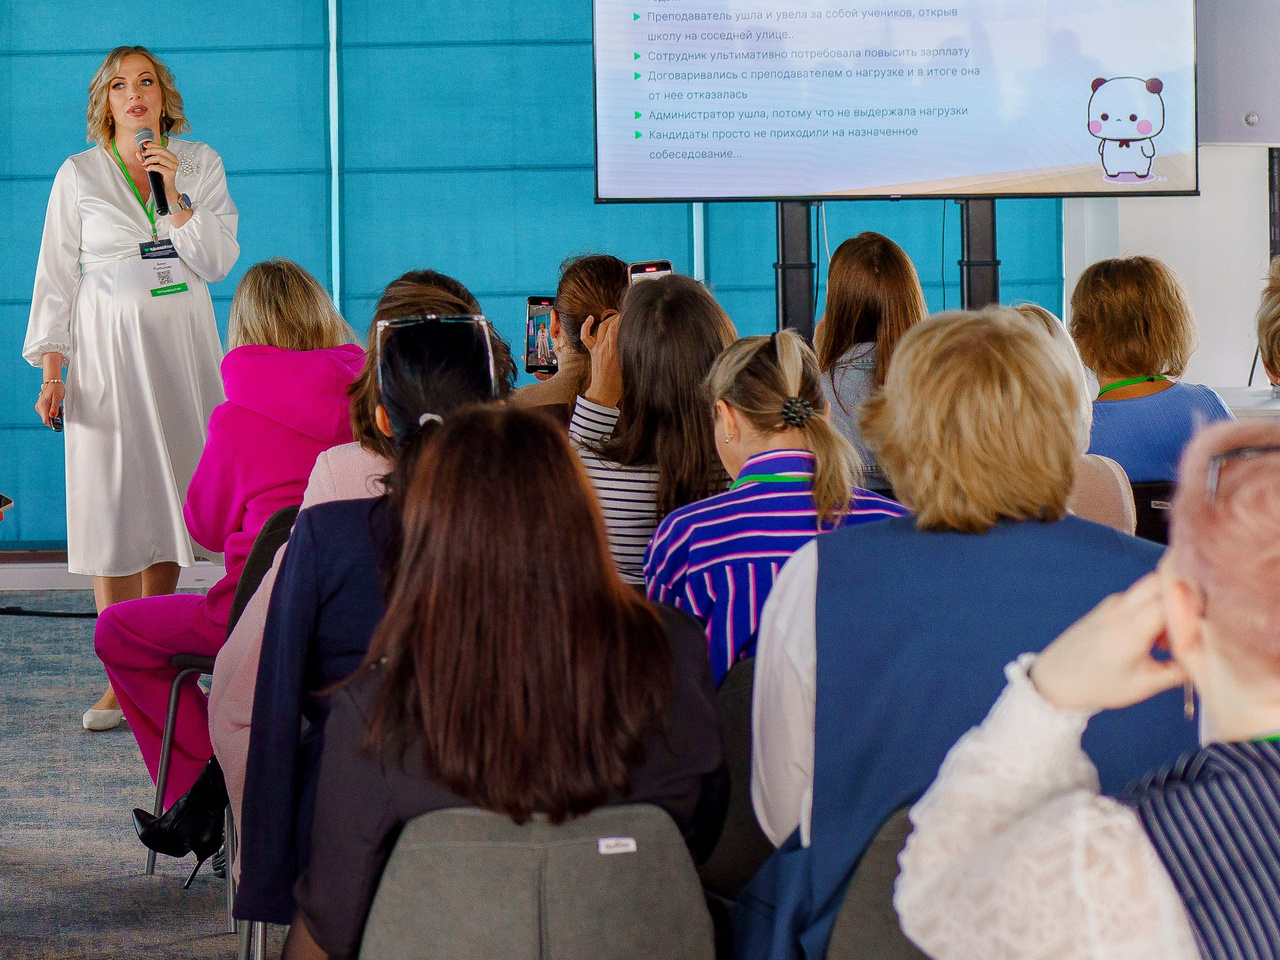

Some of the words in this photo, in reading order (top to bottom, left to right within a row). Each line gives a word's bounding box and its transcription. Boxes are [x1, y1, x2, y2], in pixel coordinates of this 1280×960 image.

[646, 10, 732, 22] Преподаватель
[734, 11, 763, 22] ушла
[775, 11, 807, 21] увела
[810, 10, 822, 19] за
[825, 8, 858, 18] собой
[860, 9, 914, 20] учеников,
[918, 7, 959, 18] открыв
[647, 33, 682, 43] школу
[684, 32, 698, 40] на
[700, 30, 753, 41] соседней
[647, 50, 707, 63] Сотрудник
[709, 51, 788, 60] ультимативно
[790, 48, 862, 59] потребовала
[864, 48, 917, 57] повысить
[920, 47, 970, 58] зарплату
[647, 69, 738, 82] Договаривались
[740, 71, 748, 79] с
[750, 69, 843, 80] преподавателем
[845, 69, 853, 78] о
[855, 68, 904, 79] нагрузке
[907, 68, 914, 76] и
[917, 68, 924, 76] в
[926, 68, 958, 76] итоге
[960, 67, 980, 76] она
[648, 92, 660, 100] от
[663, 91, 684, 100] нее
[686, 91, 748, 99] отказалась
[648, 110, 735, 121] Администратор
[737, 110, 769, 120] ушла,
[771, 109, 812, 120] потому
[815, 109, 835, 117] что
[837, 109, 851, 117] не
[853, 108, 916, 118] выдержала
[919, 107, 968, 118] нагрузки
[648, 129, 709, 140] Кандидаты
[711, 130, 751, 140] просто
[753, 130, 767, 138] не
[769, 129, 829, 139] приходили
[831, 129, 845, 137] на
[847, 128, 918, 137] назначенное
